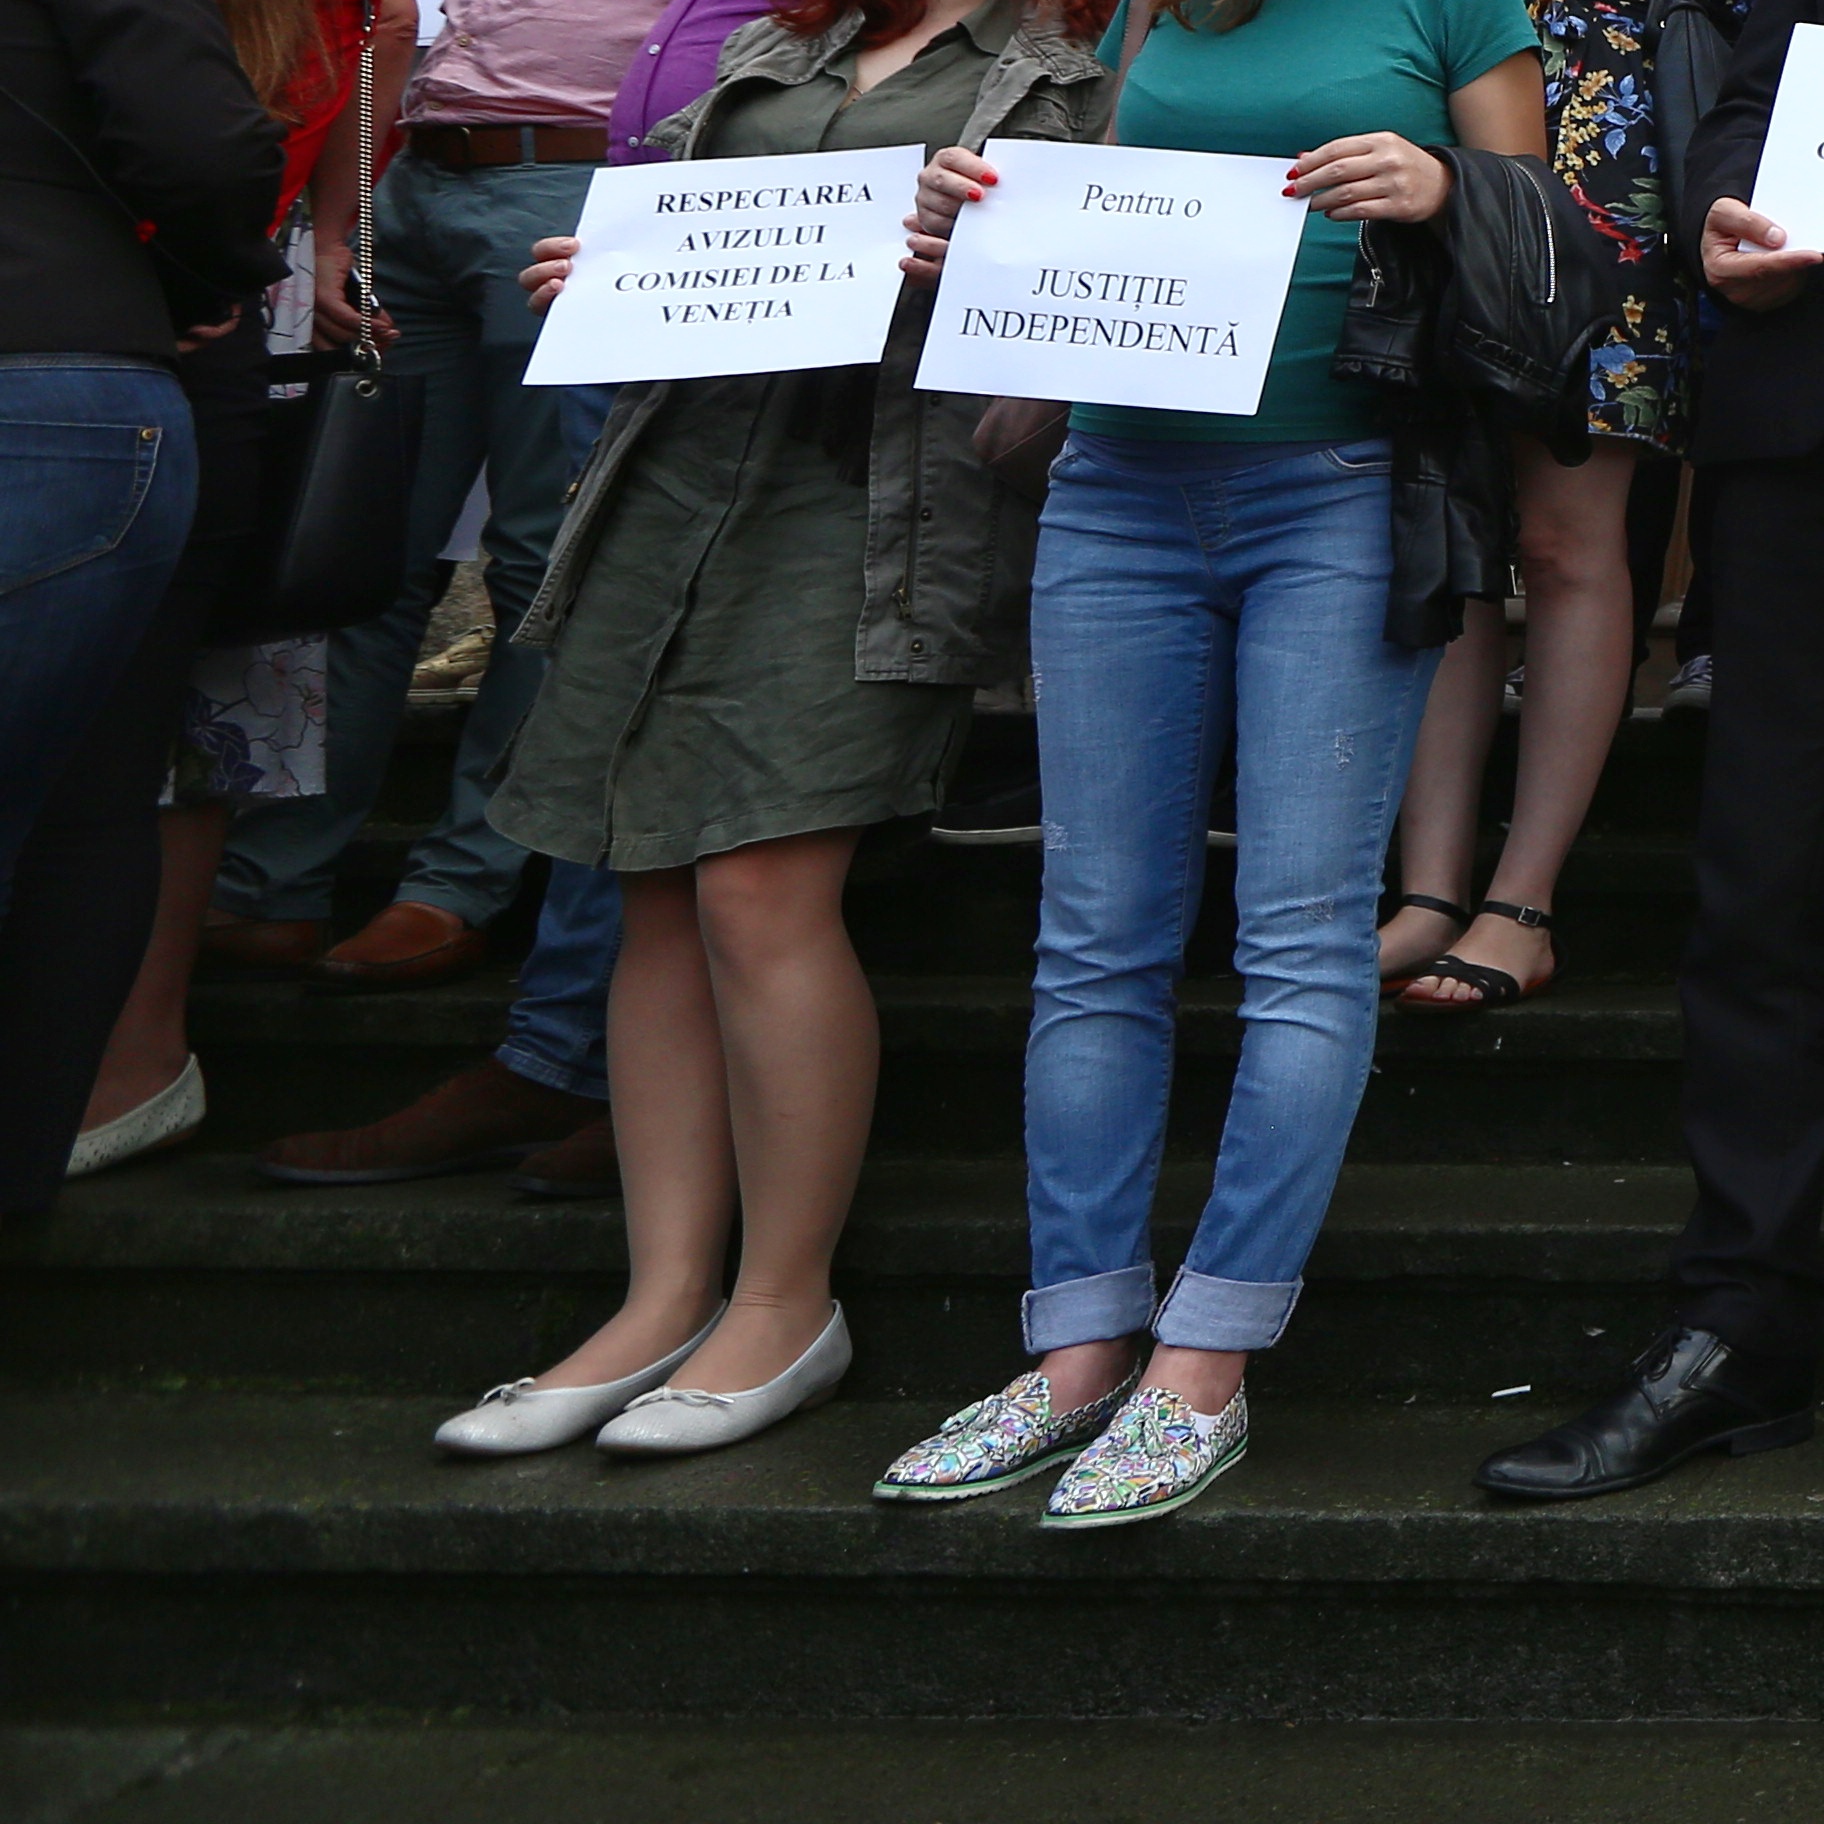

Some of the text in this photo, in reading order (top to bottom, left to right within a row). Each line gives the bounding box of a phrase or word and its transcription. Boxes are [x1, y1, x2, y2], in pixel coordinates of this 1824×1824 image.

[655, 182, 874, 214] RESPECTAREA
[1080, 183, 1202, 218] Pentru o
[676, 225, 827, 253] AVIZULUI
[614, 261, 856, 292] COMISIEI DE LA
[1031, 268, 1188, 312] JUSTIȚIE
[661, 299, 794, 325] VENEȚIA
[959, 307, 1240, 357] INDEPENDENTĂ
